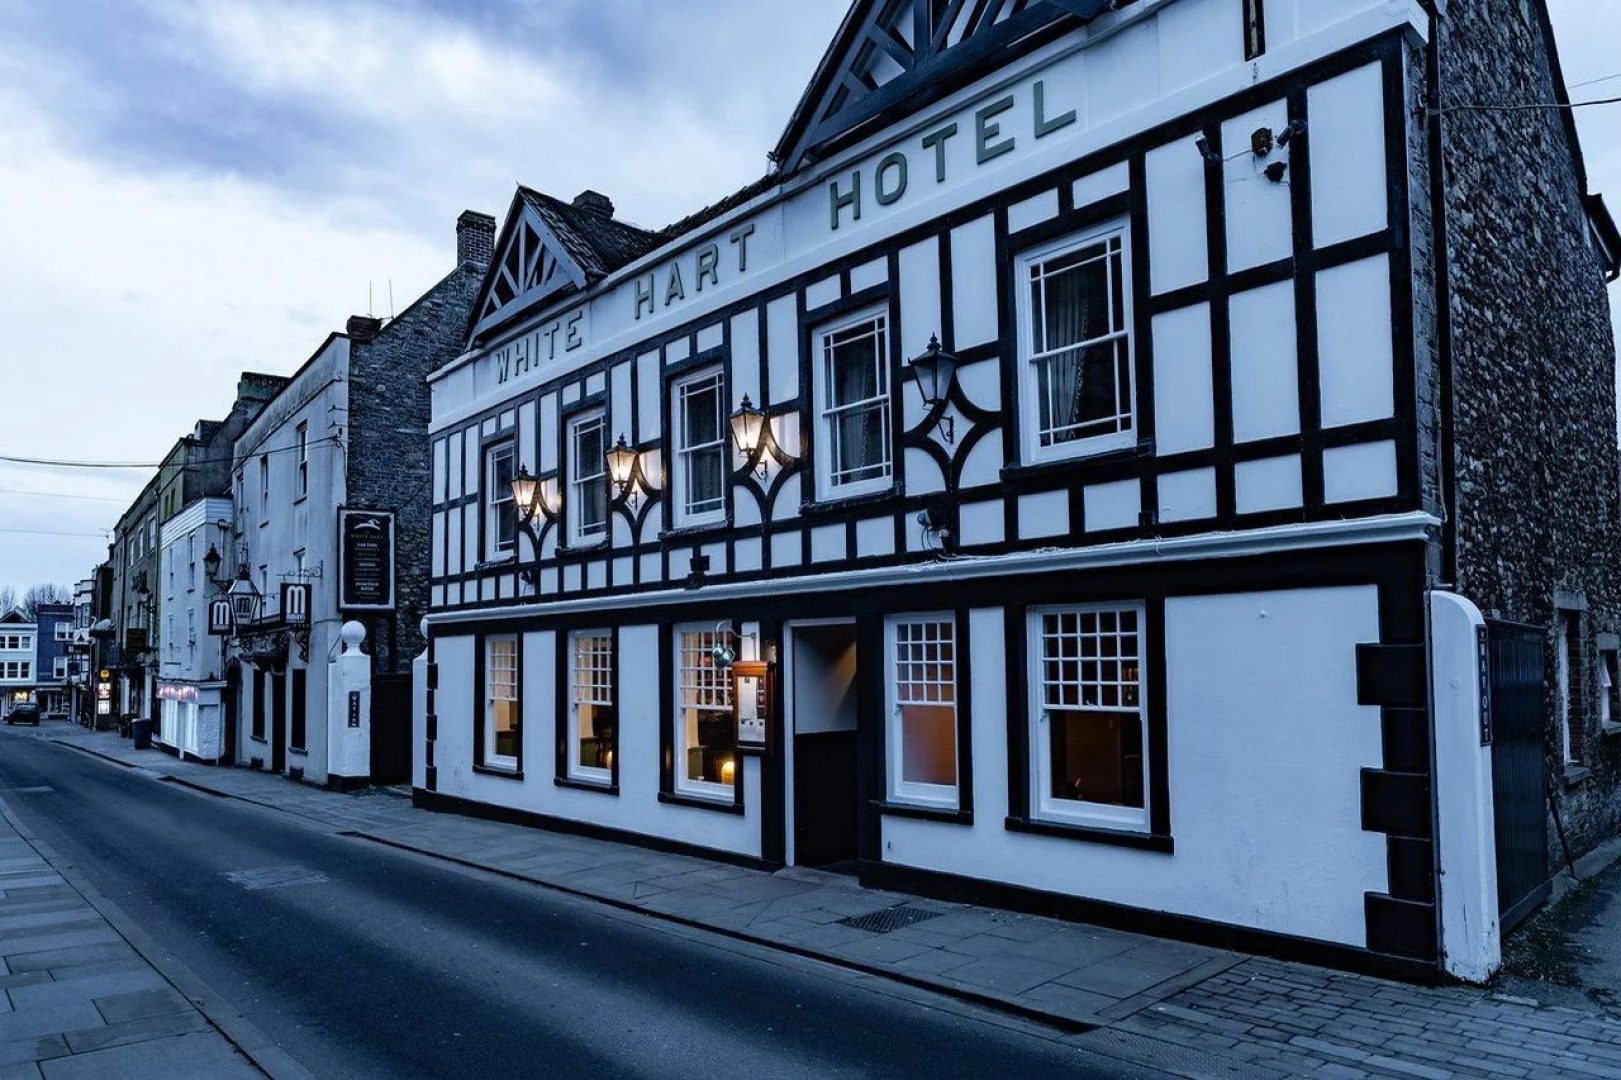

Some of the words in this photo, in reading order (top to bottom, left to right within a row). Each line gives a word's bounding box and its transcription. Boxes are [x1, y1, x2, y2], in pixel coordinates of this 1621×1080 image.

[496, 310, 583, 385] WHITE
[633, 222, 756, 320] HART
[828, 79, 1077, 230] HOTEL
